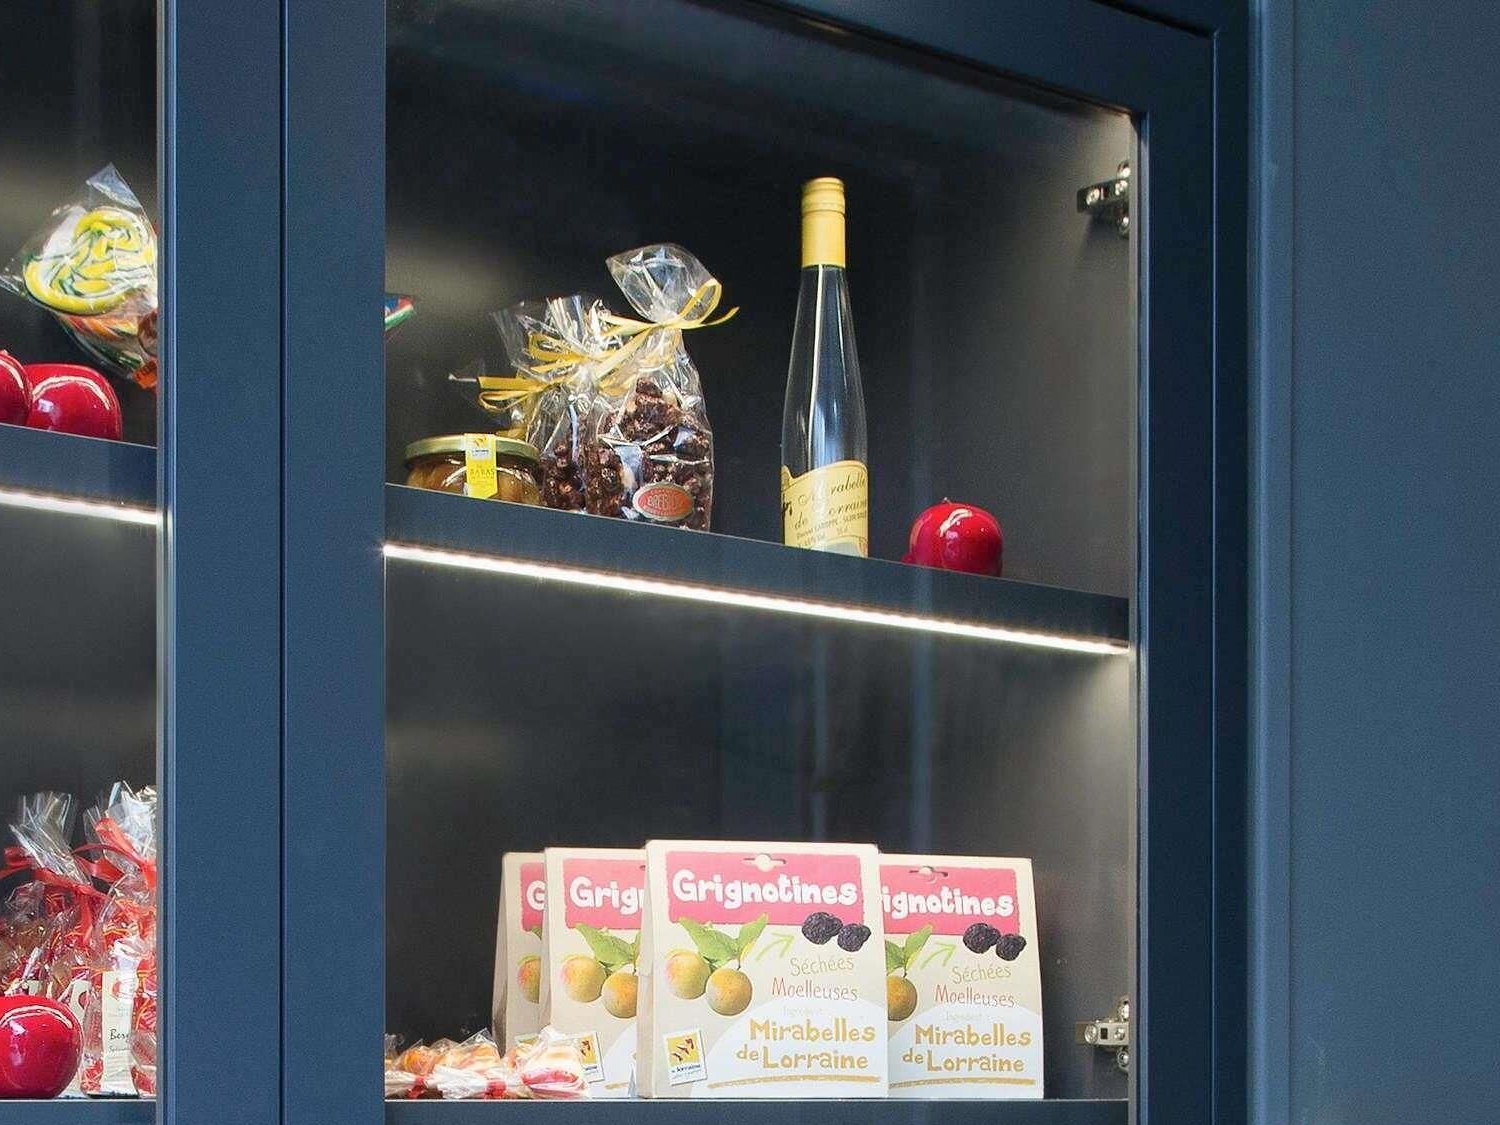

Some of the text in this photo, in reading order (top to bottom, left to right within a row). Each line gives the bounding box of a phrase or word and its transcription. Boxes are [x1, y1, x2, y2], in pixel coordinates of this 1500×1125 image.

[672, 869, 858, 910] Grignotines
[790, 955, 855, 977] Séchées
[952, 963, 1012, 985] Séchées
[771, 977, 858, 1002] Moelleuses
[934, 984, 1015, 1008] Moelleuses
[749, 1018, 876, 1043] Mirabelles
[914, 1023, 1032, 1047] Mirabelles
[736, 1044, 869, 1070] de Lorraine
[902, 1048, 1025, 1073] de Lorraine
